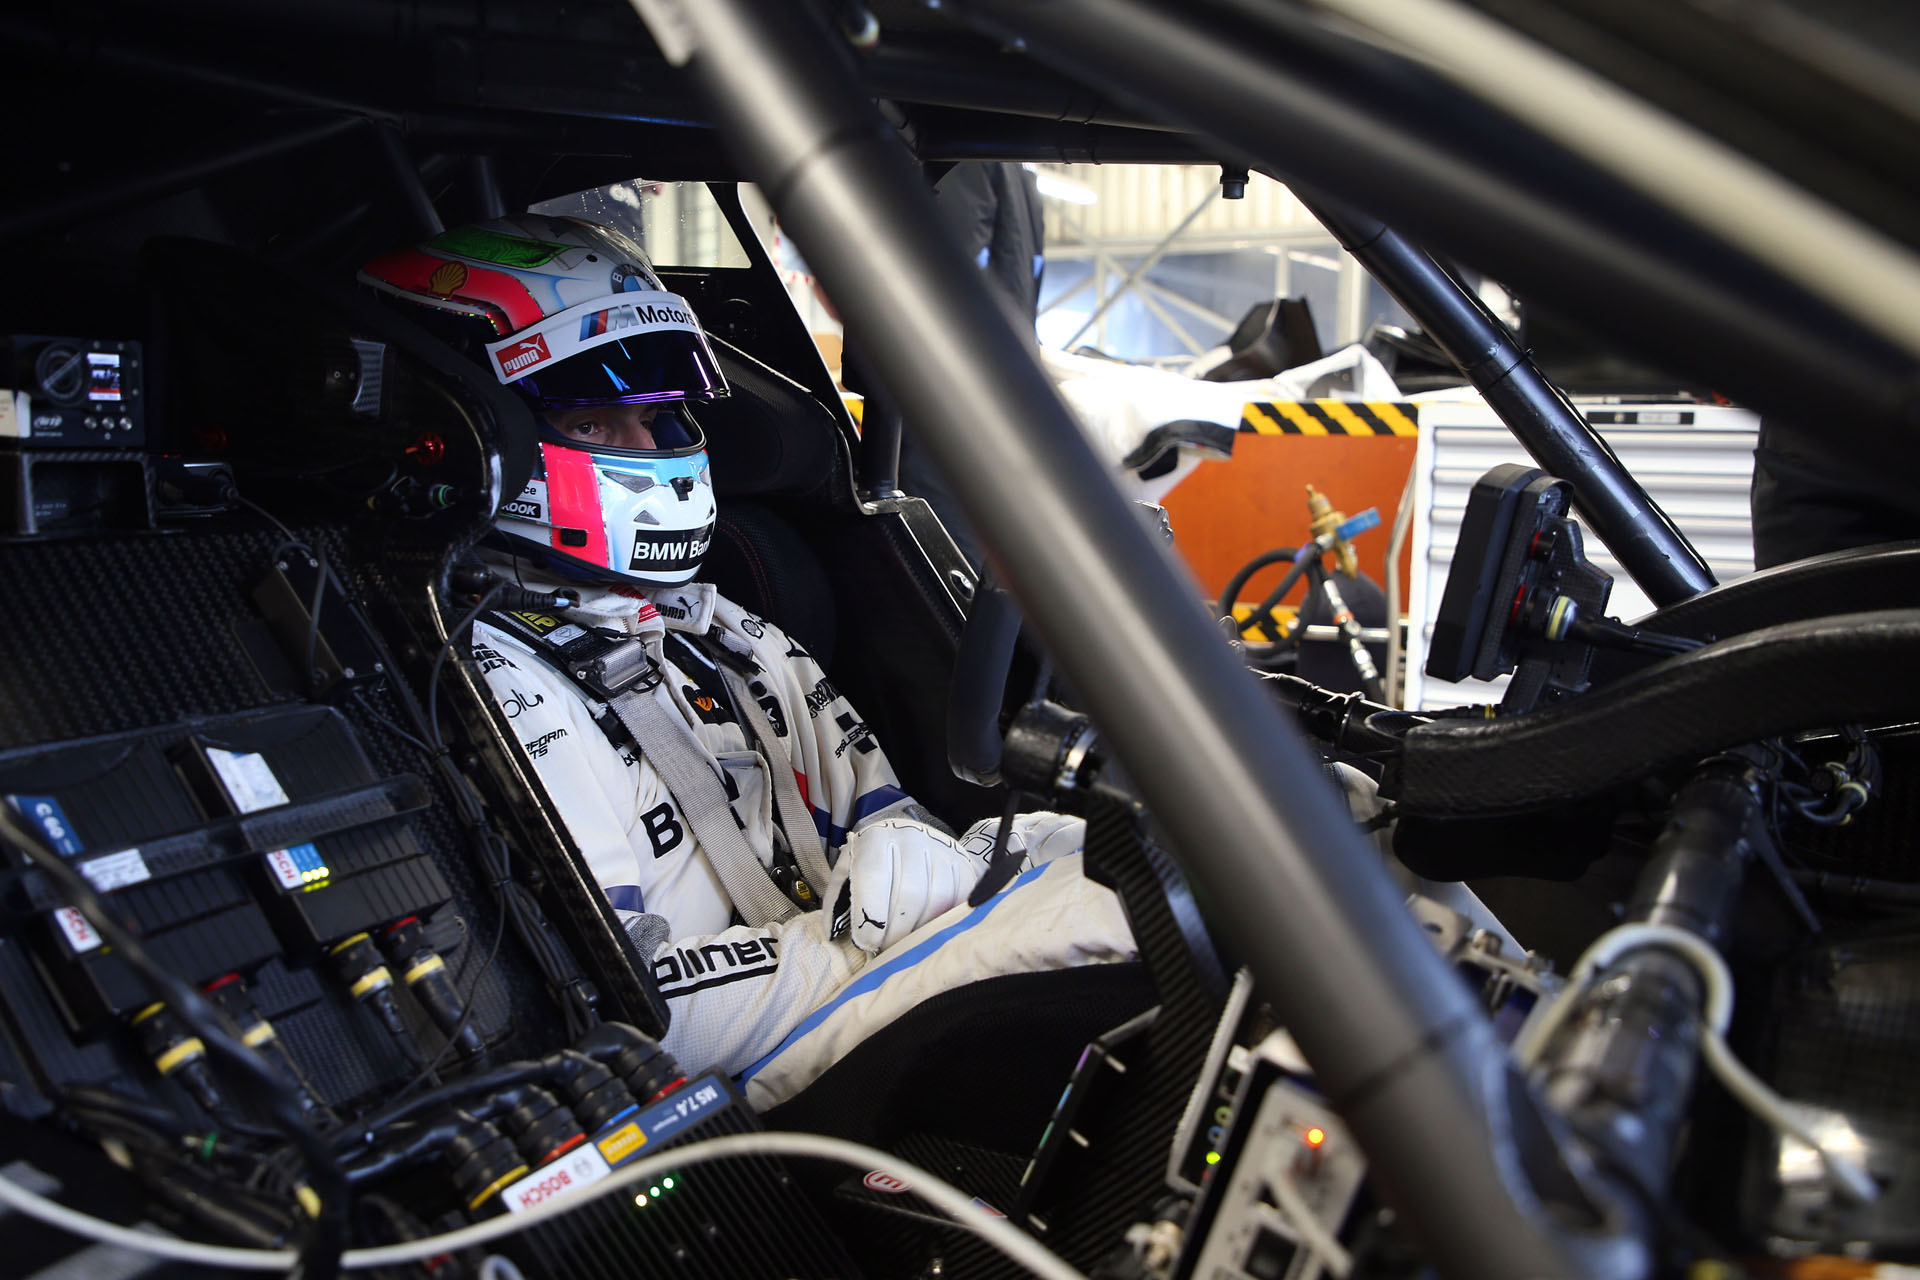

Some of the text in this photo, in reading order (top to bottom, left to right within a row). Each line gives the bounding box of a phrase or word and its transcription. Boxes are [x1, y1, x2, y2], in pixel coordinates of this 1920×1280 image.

[503, 349, 540, 373] PUMA
[633, 542, 688, 561] BMW
[518, 1169, 573, 1208] BOSCH
